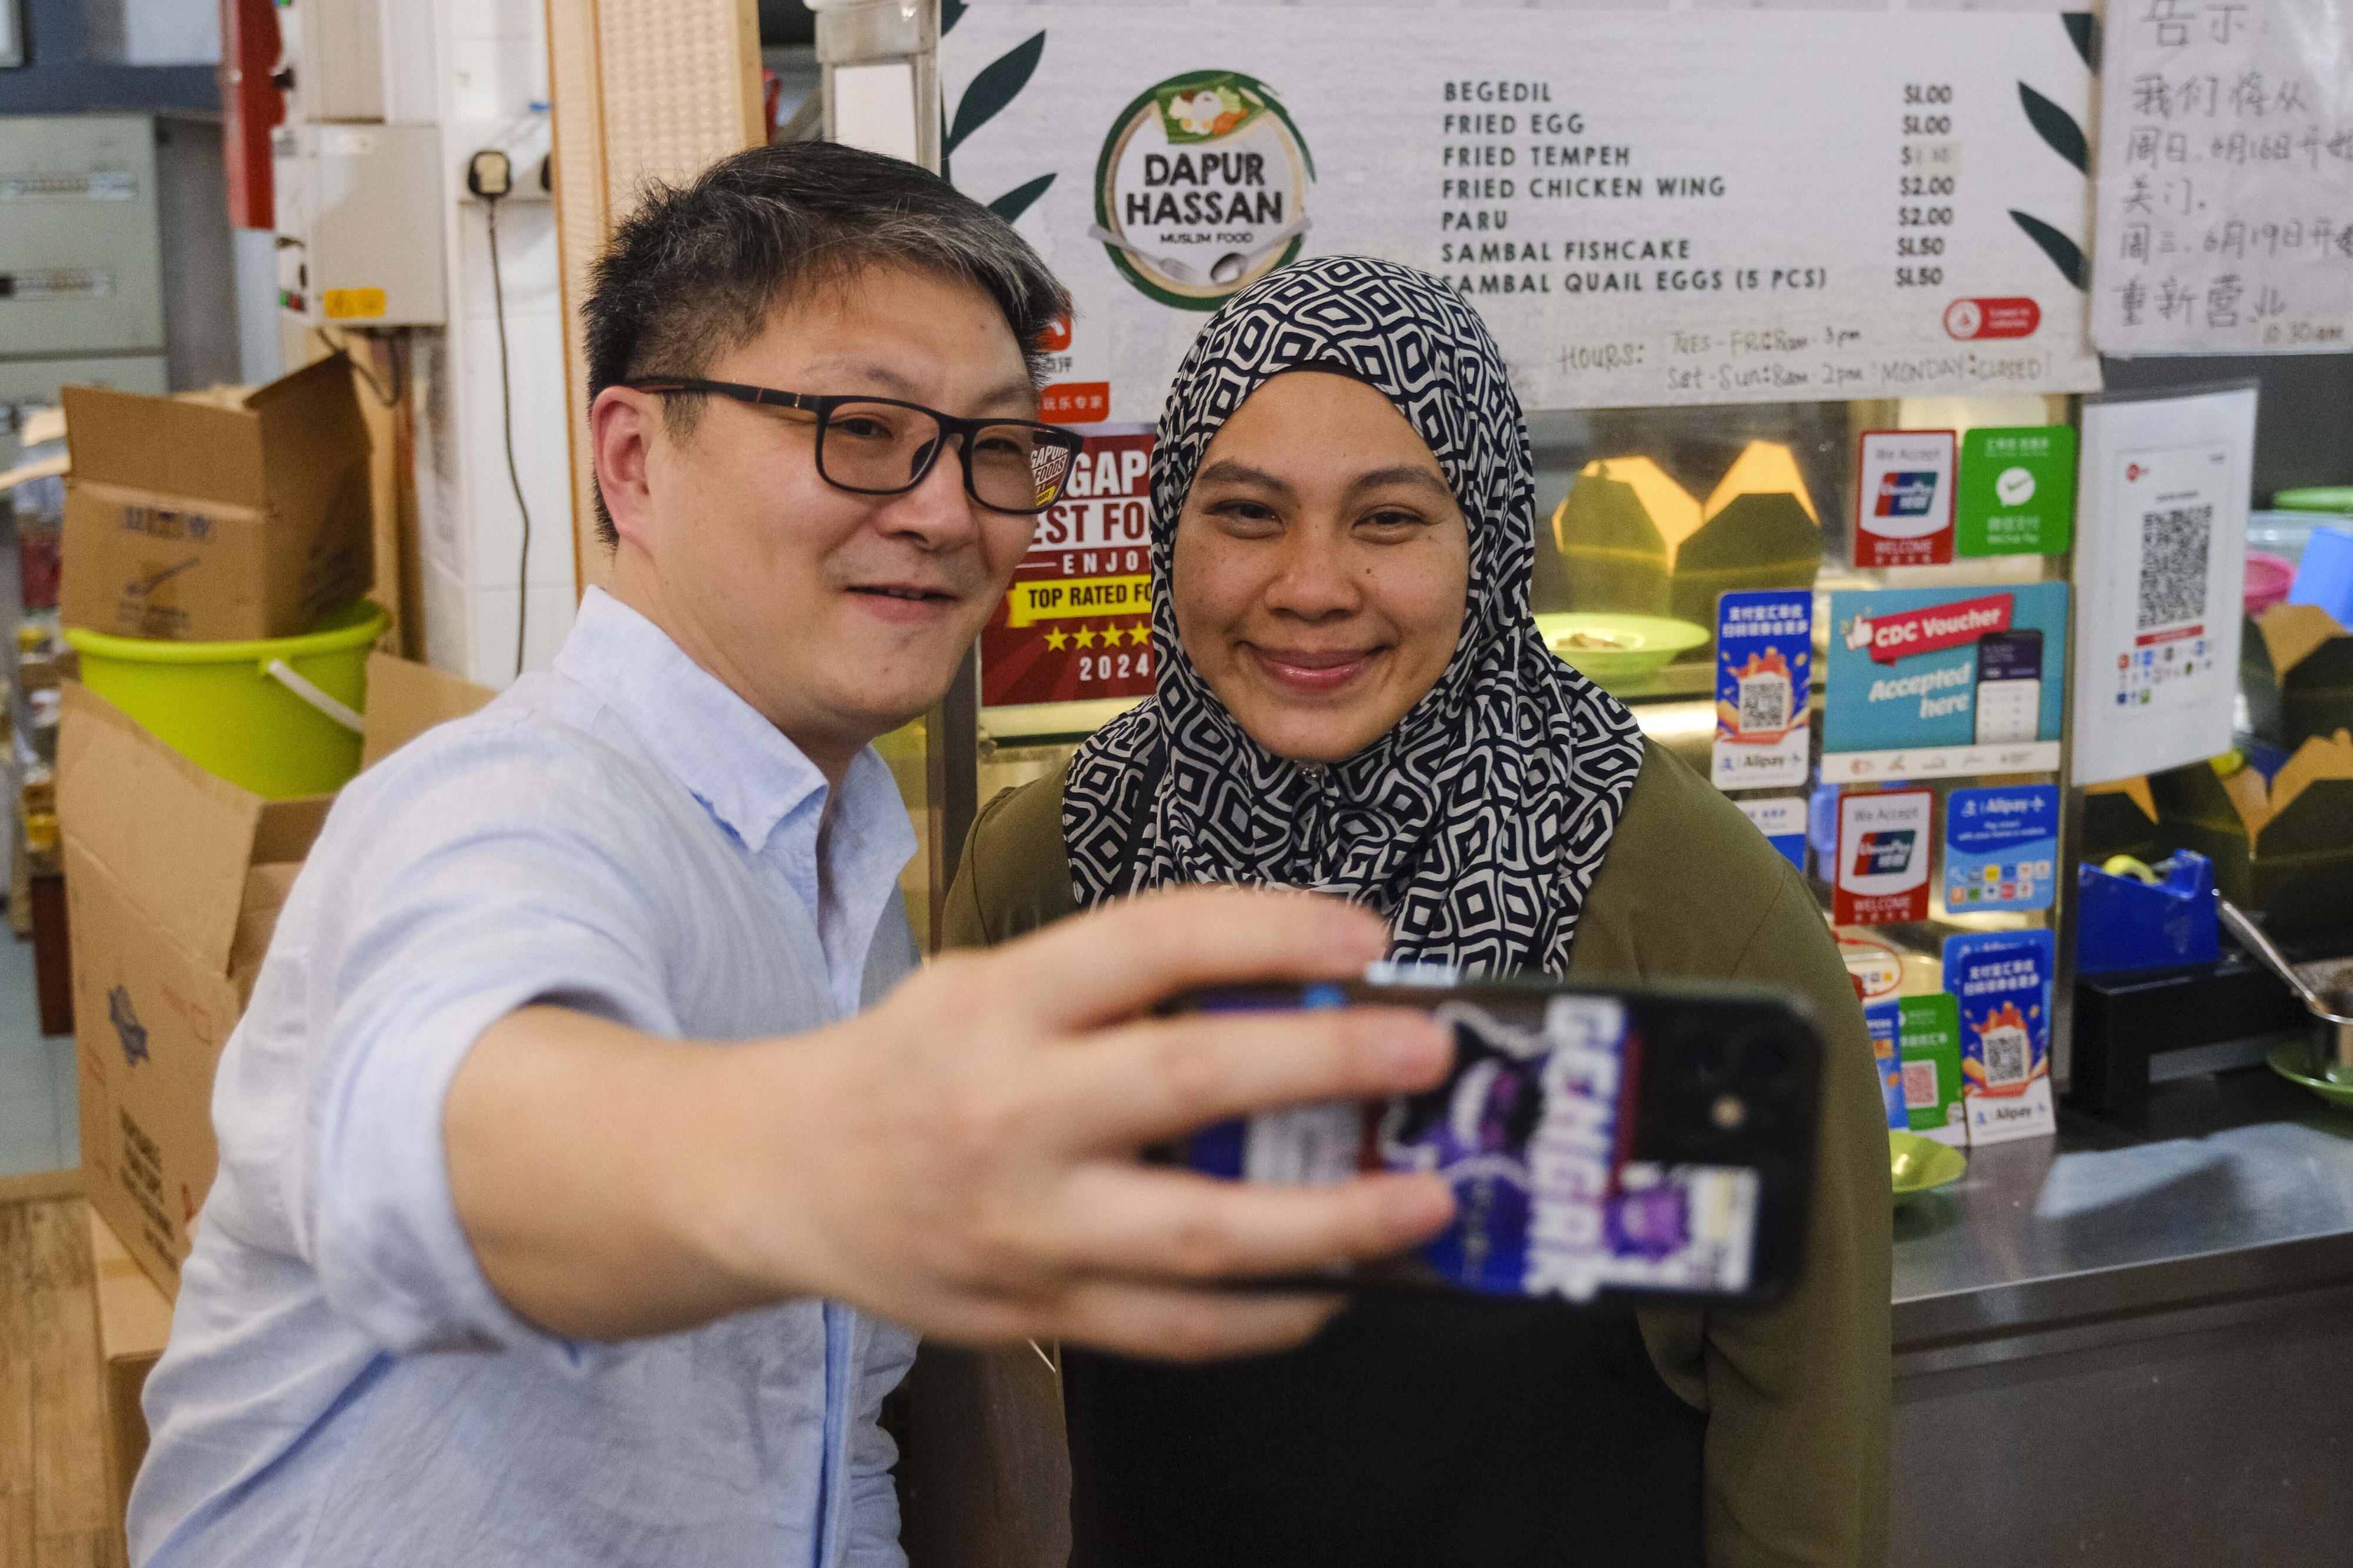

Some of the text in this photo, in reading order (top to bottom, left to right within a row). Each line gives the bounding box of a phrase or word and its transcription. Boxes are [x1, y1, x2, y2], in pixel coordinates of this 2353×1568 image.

[1444, 81, 1553, 102] BEGEDIL
[1904, 84, 1953, 105] $1.00
[1444, 113, 1585, 135] FRIED EGG
[1902, 114, 1951, 136] $1.00
[1443, 145, 1629, 167] FRIED TEMPEH
[1144, 152, 1265, 186] DAPUR
[1443, 176, 1727, 199] FRIED CHICKEN WING
[1900, 176, 1955, 196] $2.00
[1126, 191, 1283, 226] HASSAN
[1898, 207, 1954, 227] $2.00
[1442, 210, 1508, 231] PARU
[1217, 232, 1255, 243] FOOD
[1897, 237, 1945, 257] $1.50
[1442, 238, 1691, 263] SAMBAL FISHCAKE
[1565, 272, 1643, 292] QUAIL
[1656, 269, 1722, 291] EGGS
[1895, 266, 1944, 287] $1.50
[1062, 550, 1151, 575] ENJO
[1028, 589, 1062, 608] TOP
[1070, 585, 1126, 606] RATED
[1875, 608, 2002, 648] CDC Voucher
[1079, 653, 1149, 682] 2024
[1868, 661, 1971, 702] Accepted
[1919, 692, 1970, 719] here
